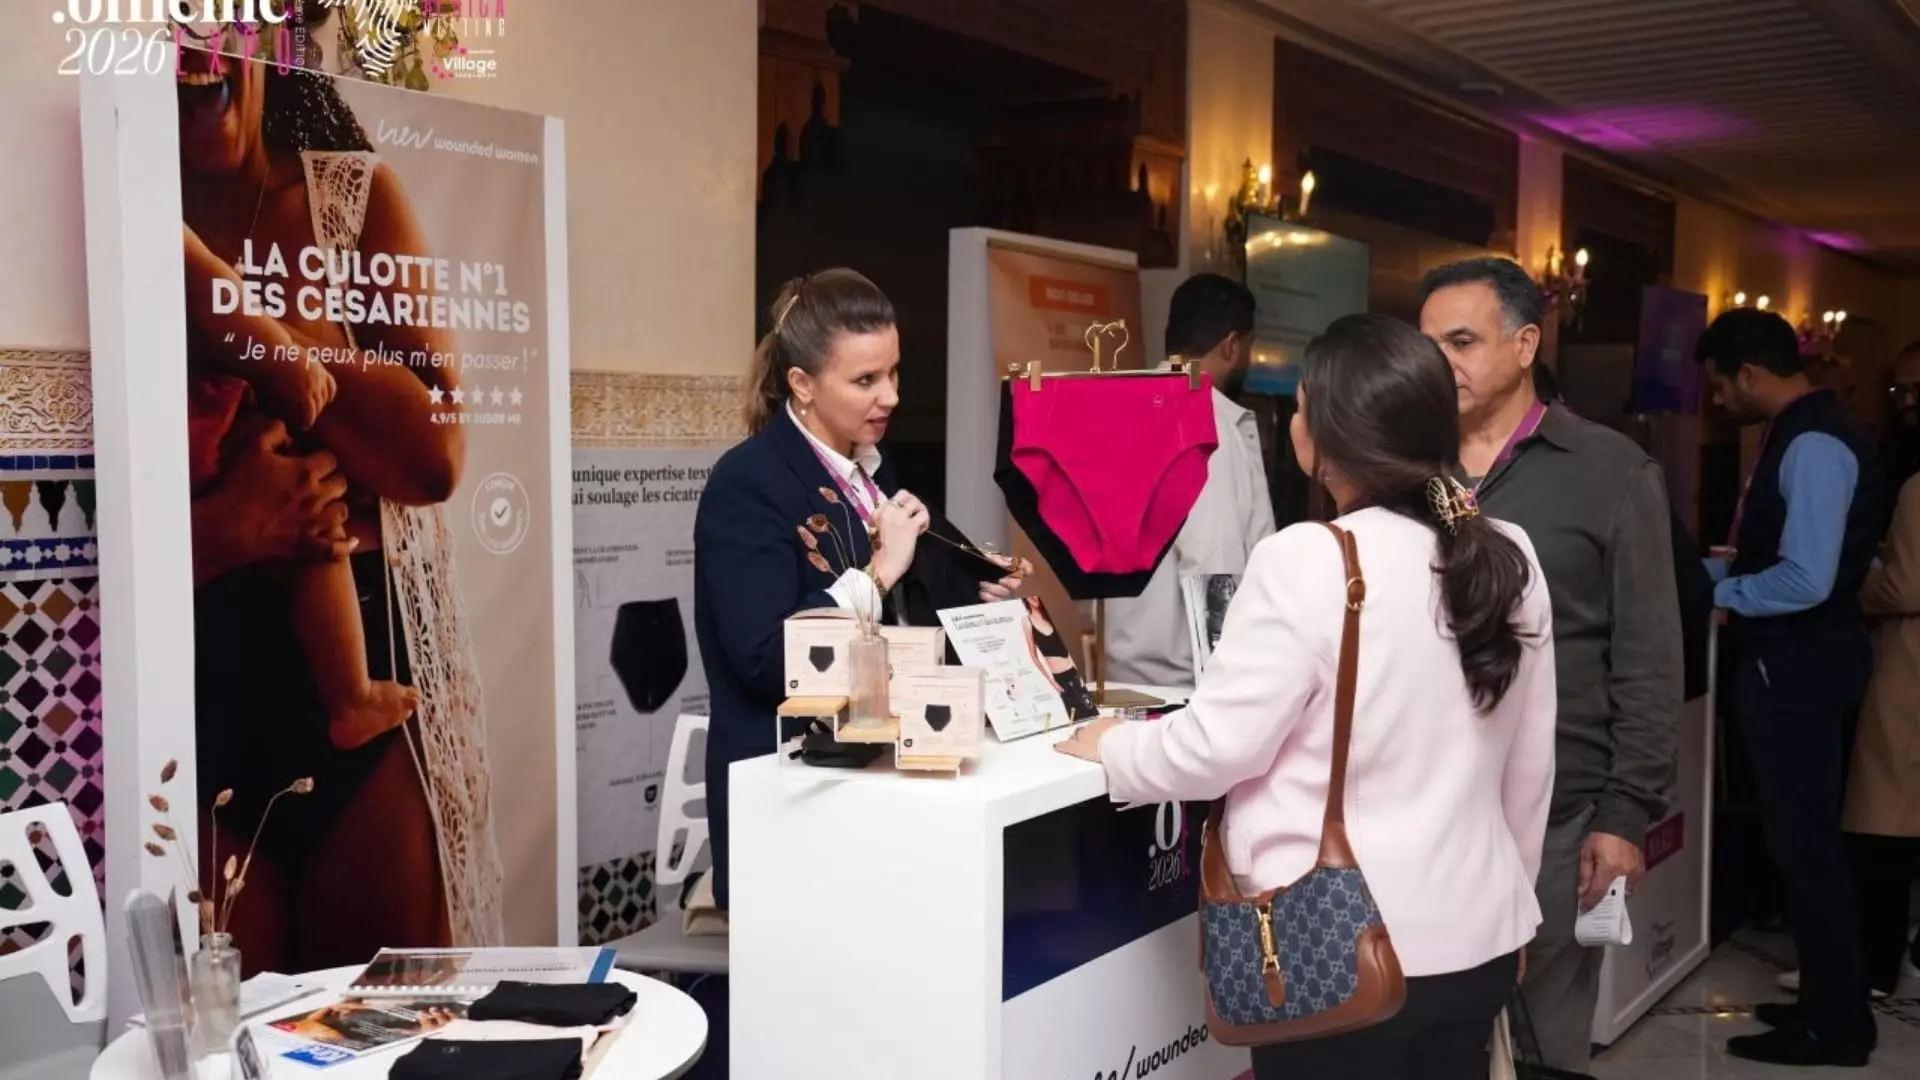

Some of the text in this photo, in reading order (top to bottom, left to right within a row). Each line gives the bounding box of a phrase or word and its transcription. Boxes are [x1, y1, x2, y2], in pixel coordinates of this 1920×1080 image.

[434, 136, 494, 157] wounded
[495, 147, 539, 165] women
[244, 239, 508, 296] LA CULOTTE N°1
[212, 278, 286, 319] DES
[240, 336, 266, 360] Je
[273, 343, 300, 362] ne
[306, 346, 357, 371] peux
[363, 341, 404, 373] plus
[461, 350, 519, 375] passer
[572, 464, 620, 486] unique
[624, 464, 685, 485] expertise
[587, 487, 639, 507] soulage
[642, 487, 661, 503] les
[1148, 850, 1181, 891] 2026
